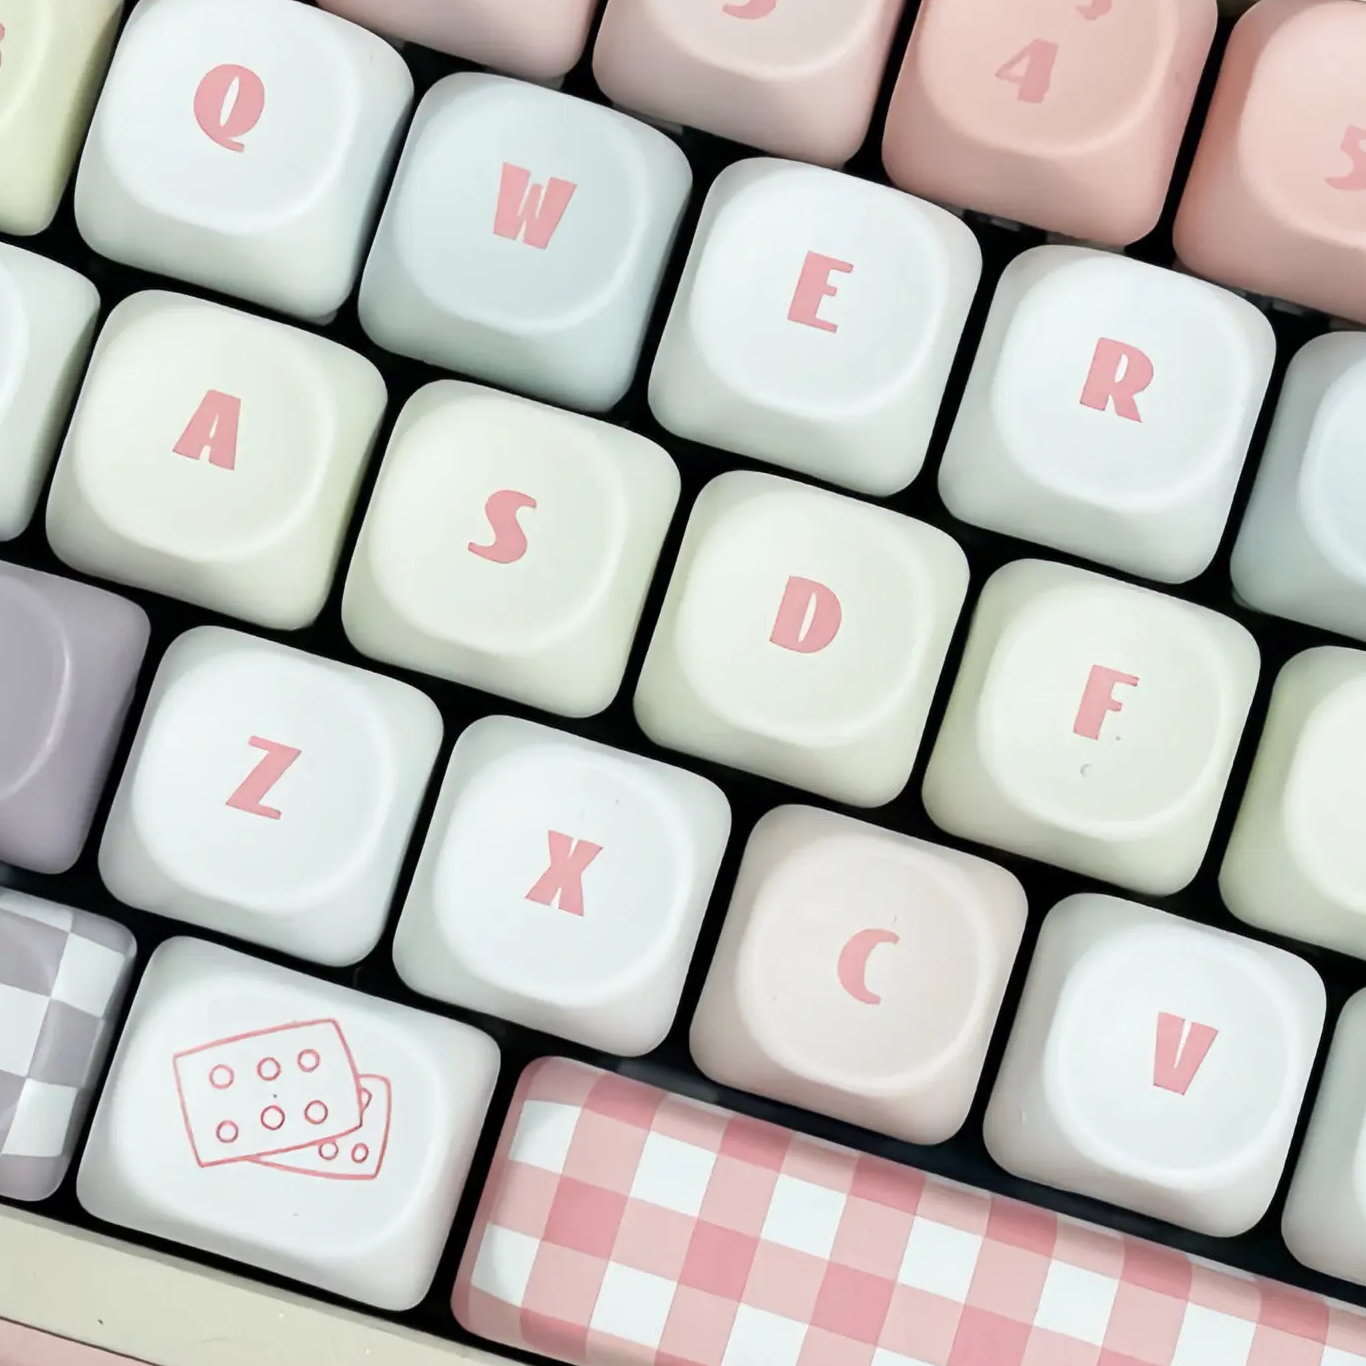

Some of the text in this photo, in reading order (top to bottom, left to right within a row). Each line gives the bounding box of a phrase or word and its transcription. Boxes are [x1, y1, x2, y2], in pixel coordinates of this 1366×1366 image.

[193, 63, 266, 153] Q
[994, 38, 1059, 104] 4
[492, 162, 578, 250] W
[787, 250, 855, 334] E
[1079, 337, 1154, 424] R
[171, 389, 242, 471] A
[467, 489, 538, 565] S
[768, 575, 842, 654] D
[1072, 664, 1140, 741] F
[225, 735, 303, 821] Z
[524, 829, 604, 917] X
[837, 928, 900, 1006] C
[1152, 1012, 1220, 1097] V
